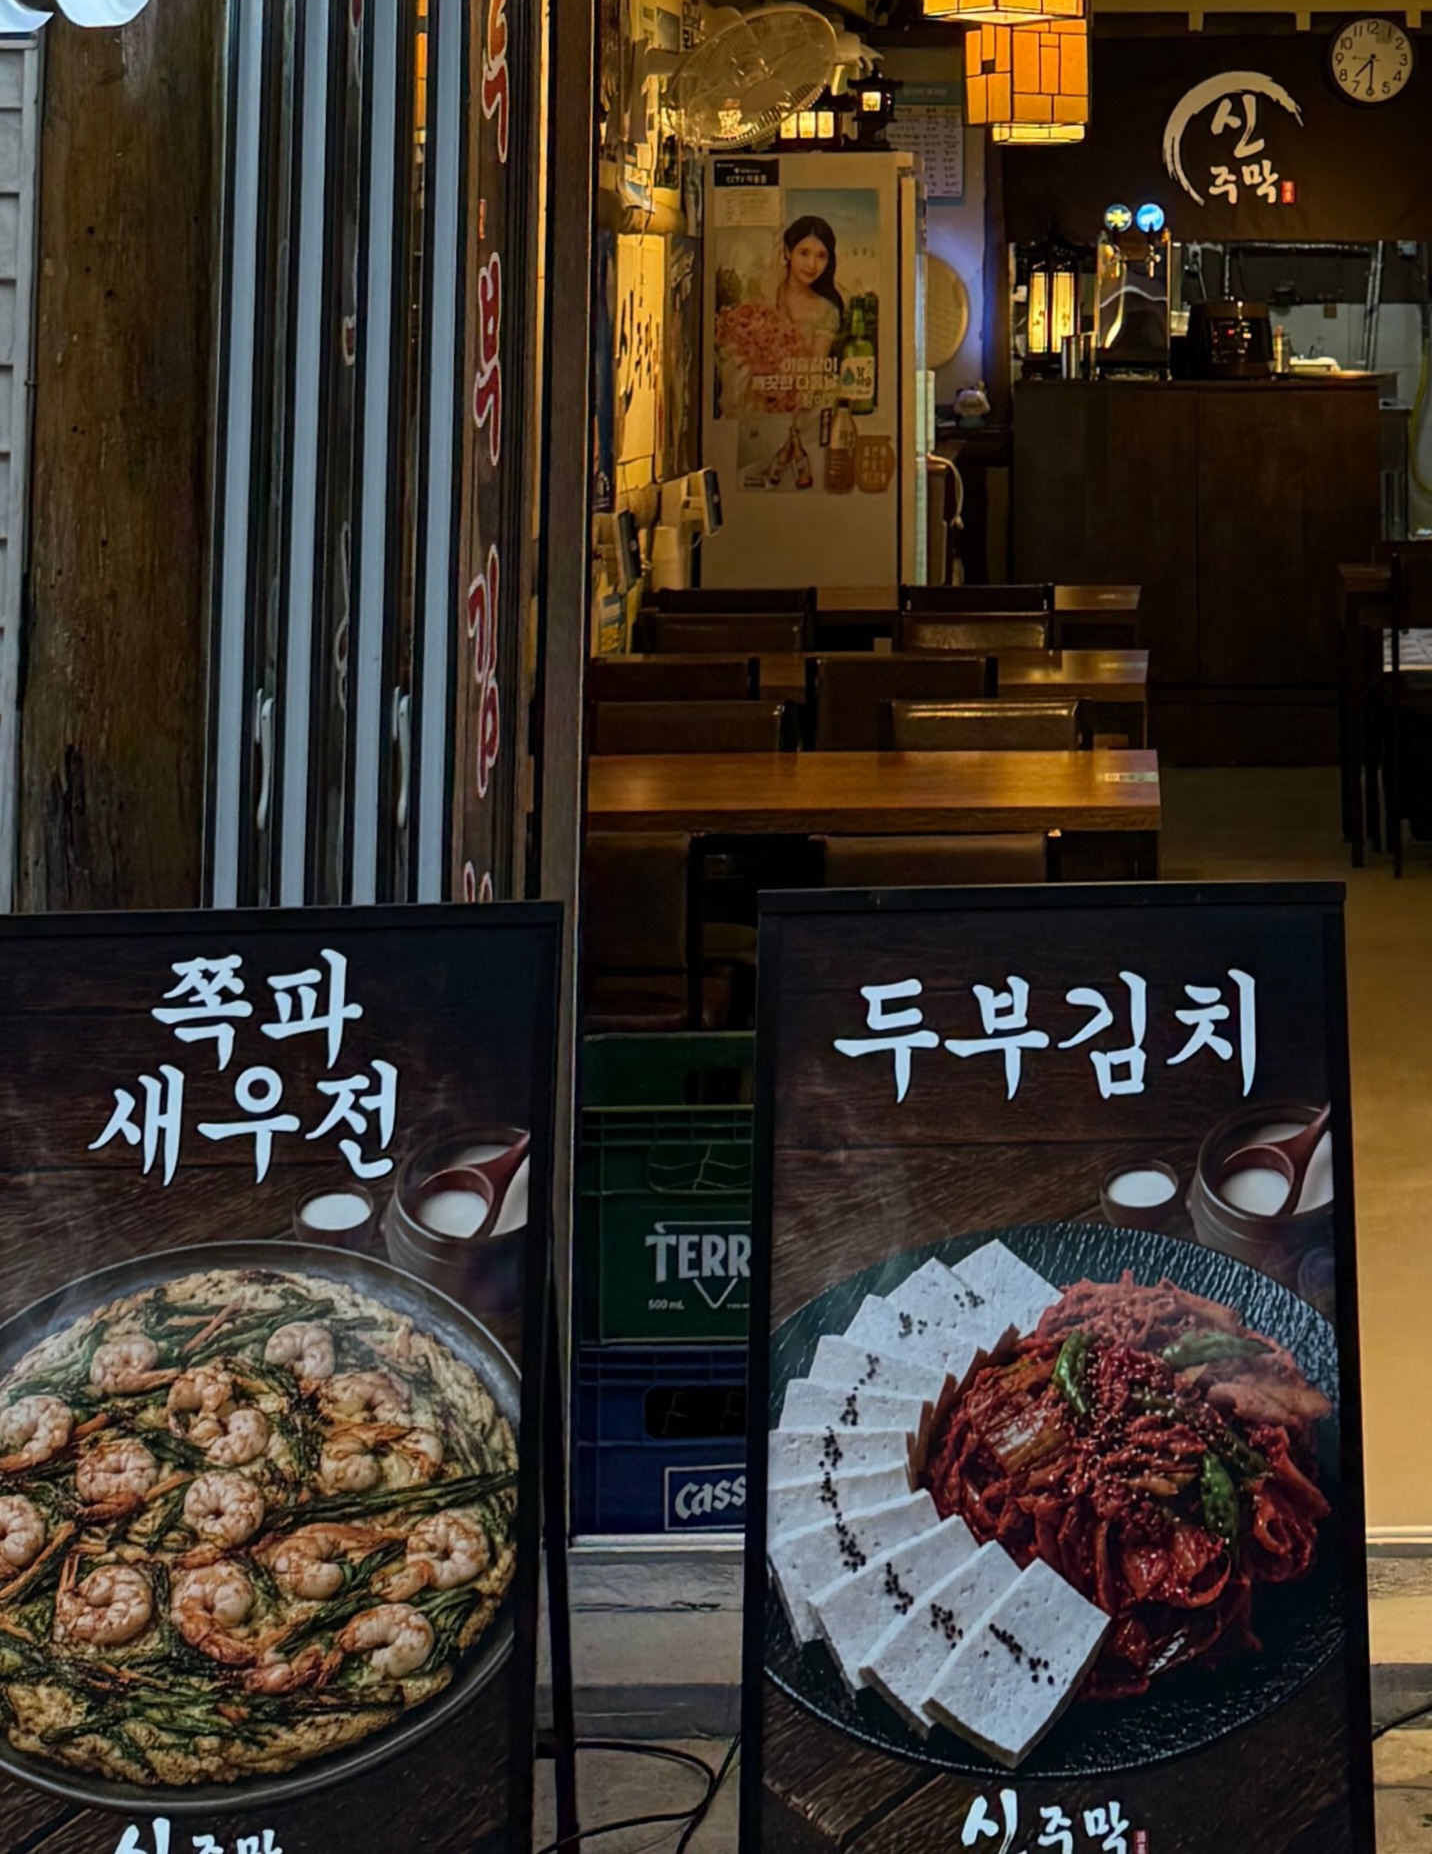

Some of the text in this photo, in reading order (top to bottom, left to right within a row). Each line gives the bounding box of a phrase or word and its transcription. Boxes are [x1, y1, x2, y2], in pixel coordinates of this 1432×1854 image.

[1210, 94, 1265, 158] 신
[1208, 159, 1279, 204] 주막
[151, 948, 363, 1071] 쪽파
[833, 968, 1258, 1103] 두부김치
[87, 1058, 399, 1186] 새우전
[645, 1233, 752, 1283] TERR
